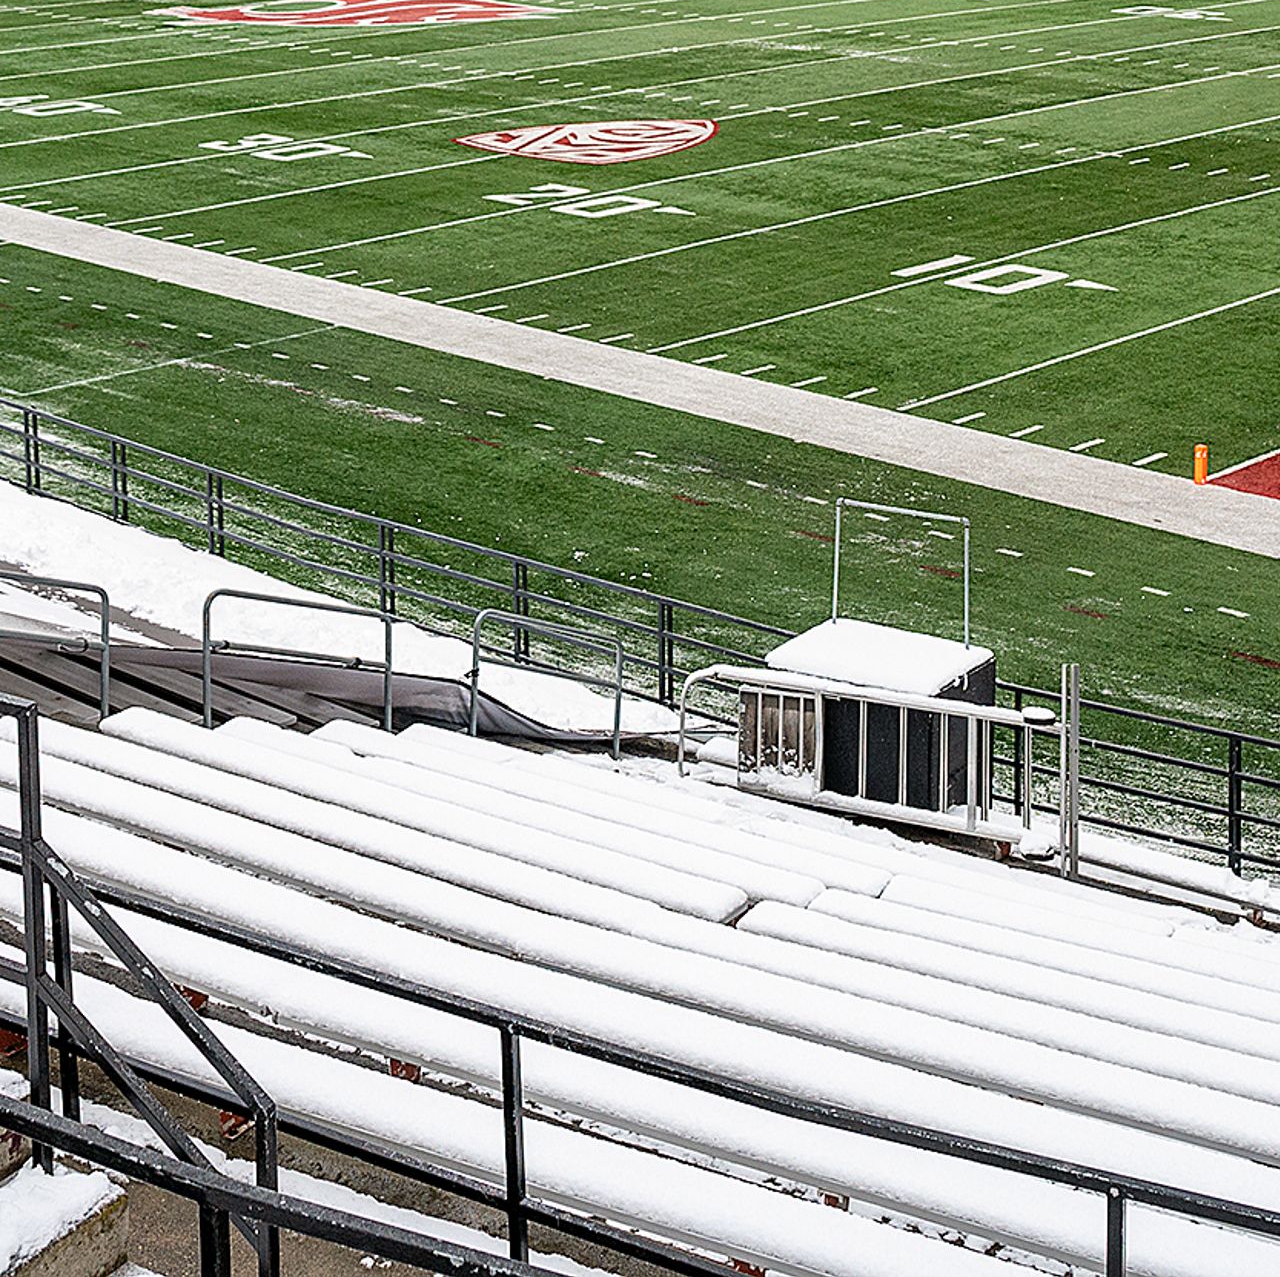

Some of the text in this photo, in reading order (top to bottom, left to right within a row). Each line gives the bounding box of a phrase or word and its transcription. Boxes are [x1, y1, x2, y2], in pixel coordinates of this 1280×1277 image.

[198, 133, 351, 162] 30
[482, 183, 663, 219] 20
[890, 254, 1071, 295] 10
